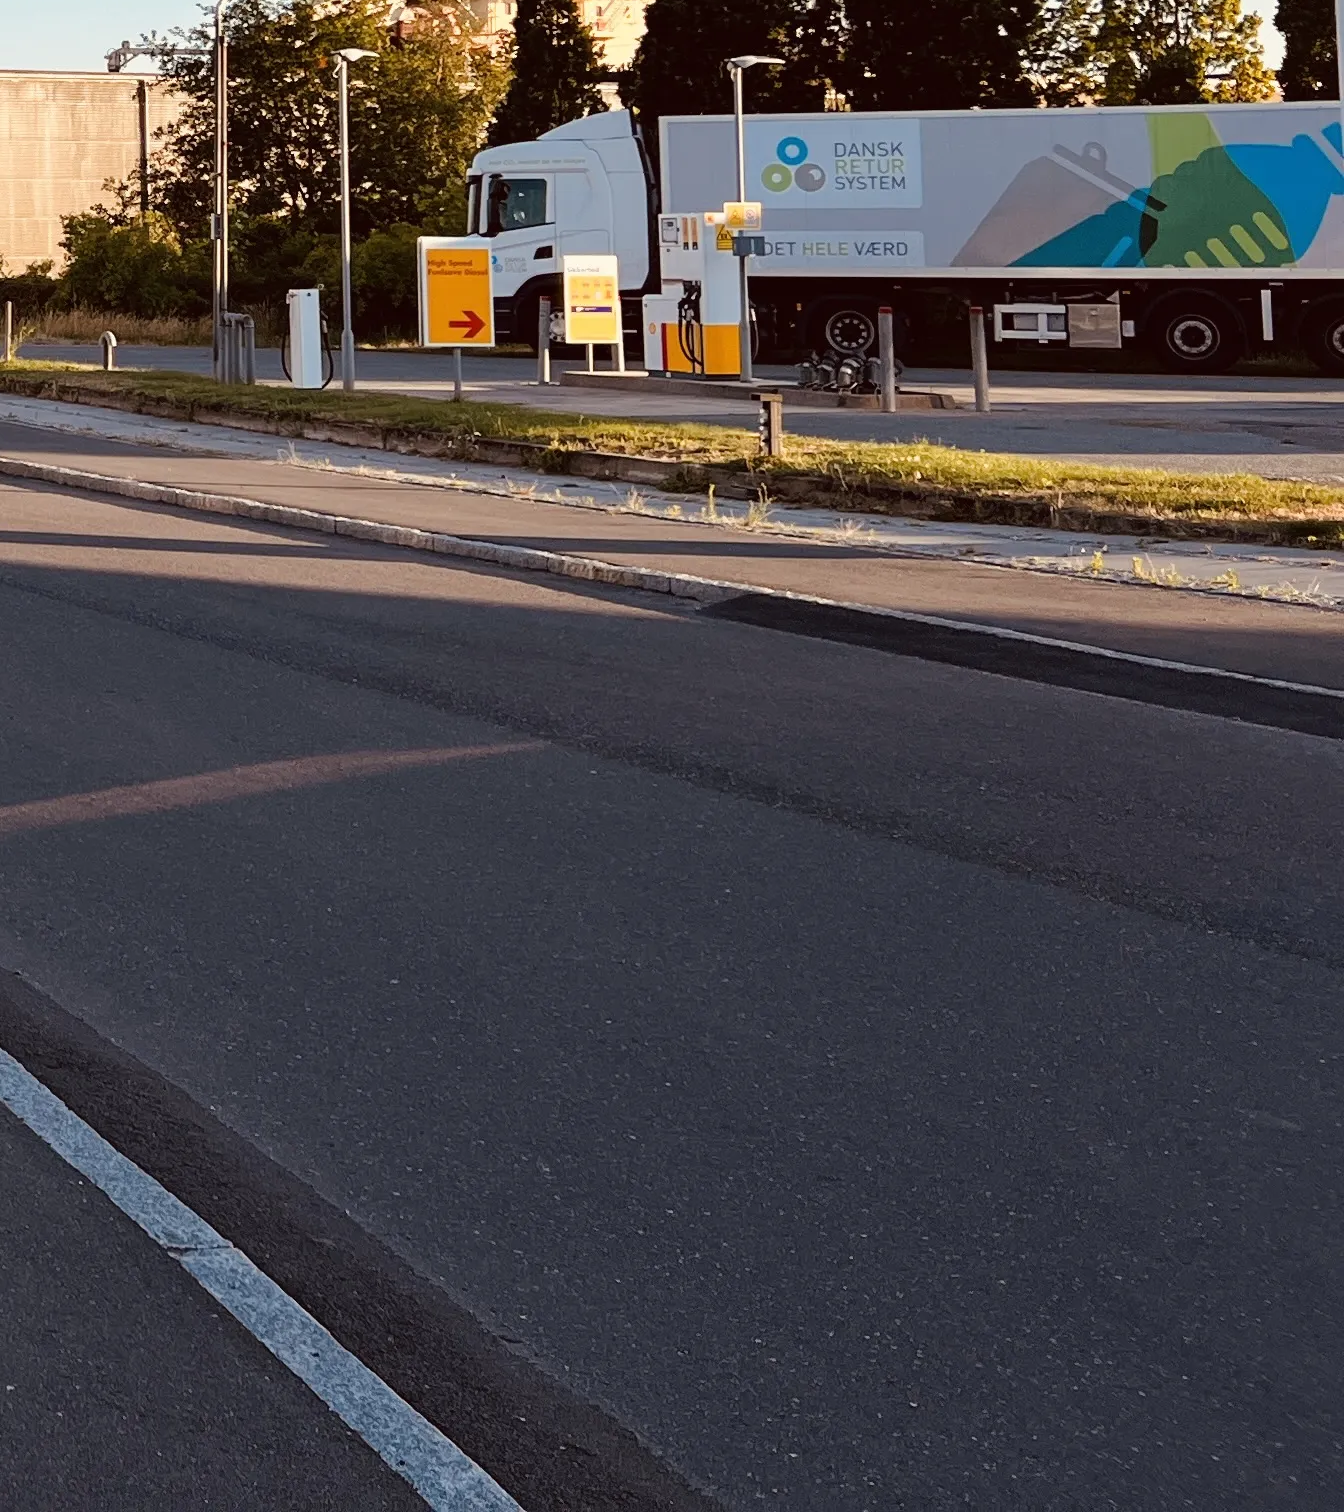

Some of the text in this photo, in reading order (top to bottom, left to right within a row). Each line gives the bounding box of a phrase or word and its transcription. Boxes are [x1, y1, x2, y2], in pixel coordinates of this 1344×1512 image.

[834, 142, 904, 157] DANSK
[835, 159, 905, 175] RETUR
[835, 176, 906, 190] SYSTEM
[764, 241, 908, 256] DET HELE VÆRD
[427, 259, 473, 268] High Speed
